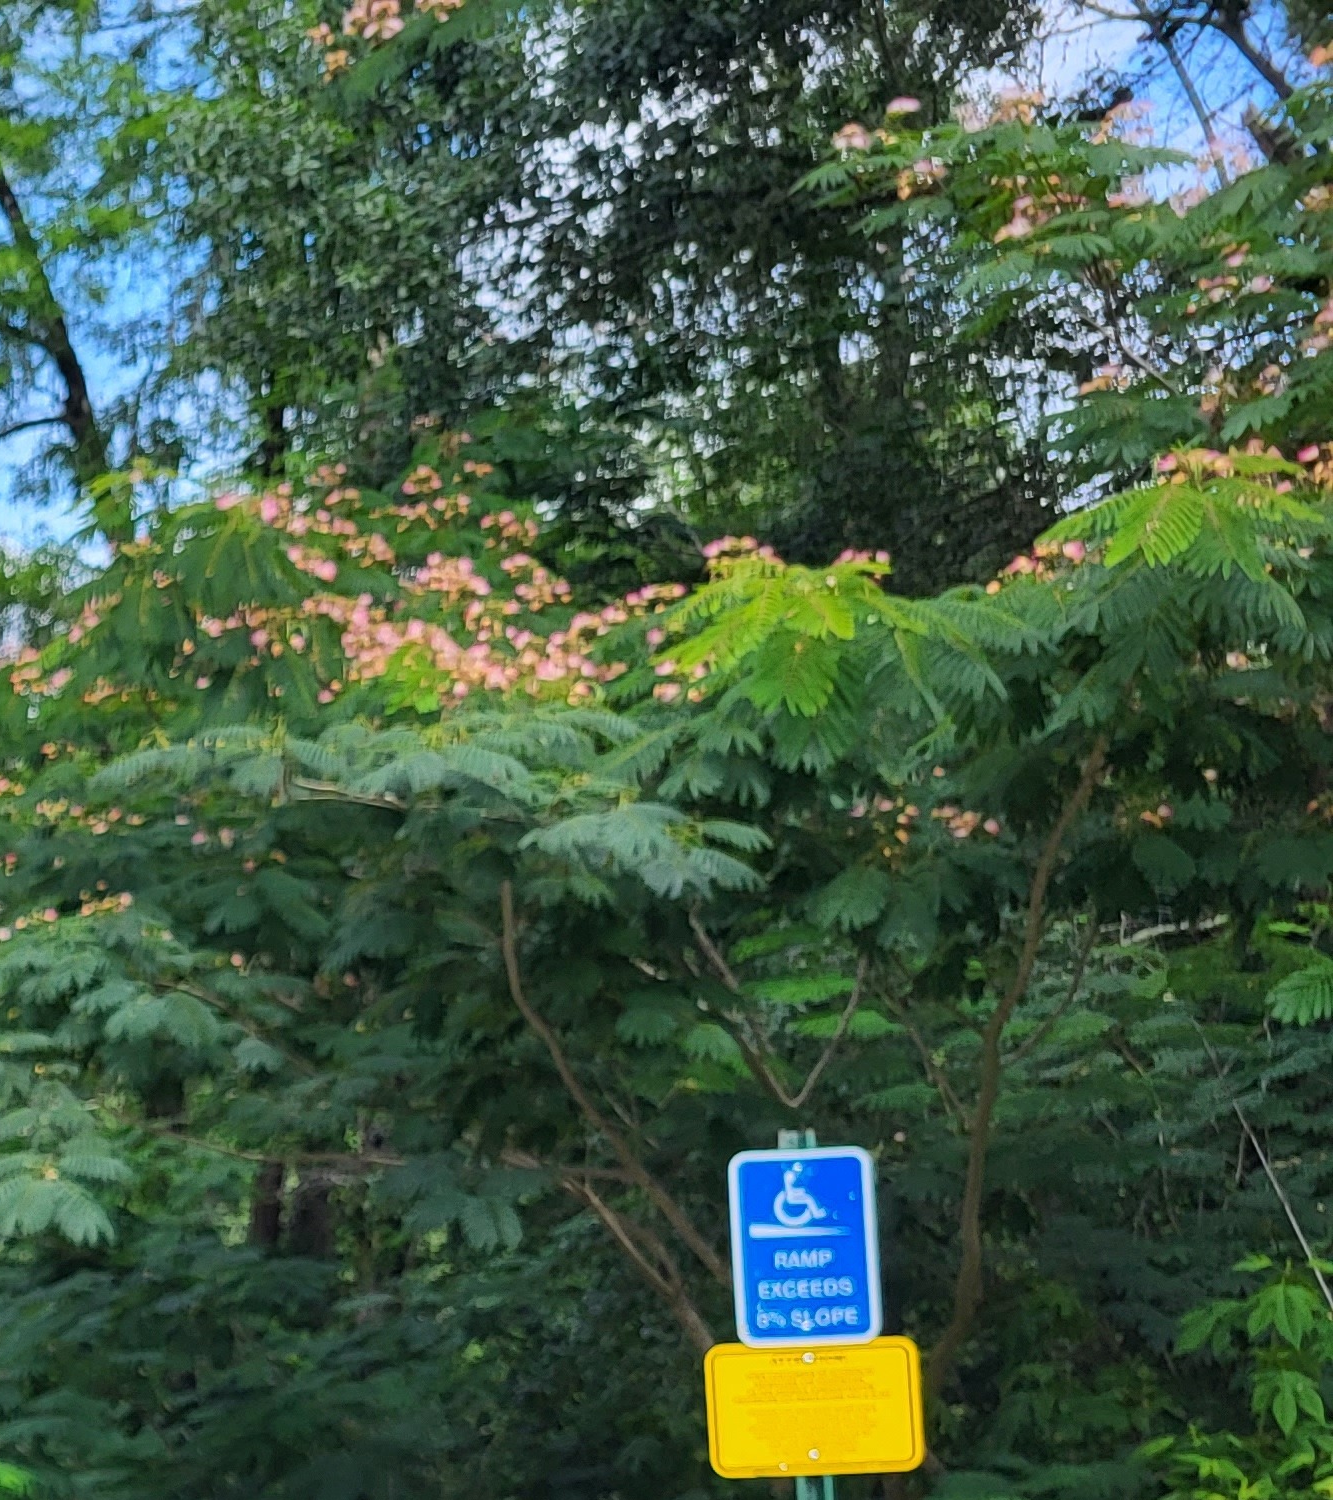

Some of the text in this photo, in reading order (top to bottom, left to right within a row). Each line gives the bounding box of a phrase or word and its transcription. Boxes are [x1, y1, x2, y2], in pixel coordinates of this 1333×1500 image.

[774, 1249, 833, 1270] RAMP
[758, 1277, 854, 1299] EXCEEDS
[790, 1306, 859, 1329] SLOPE
